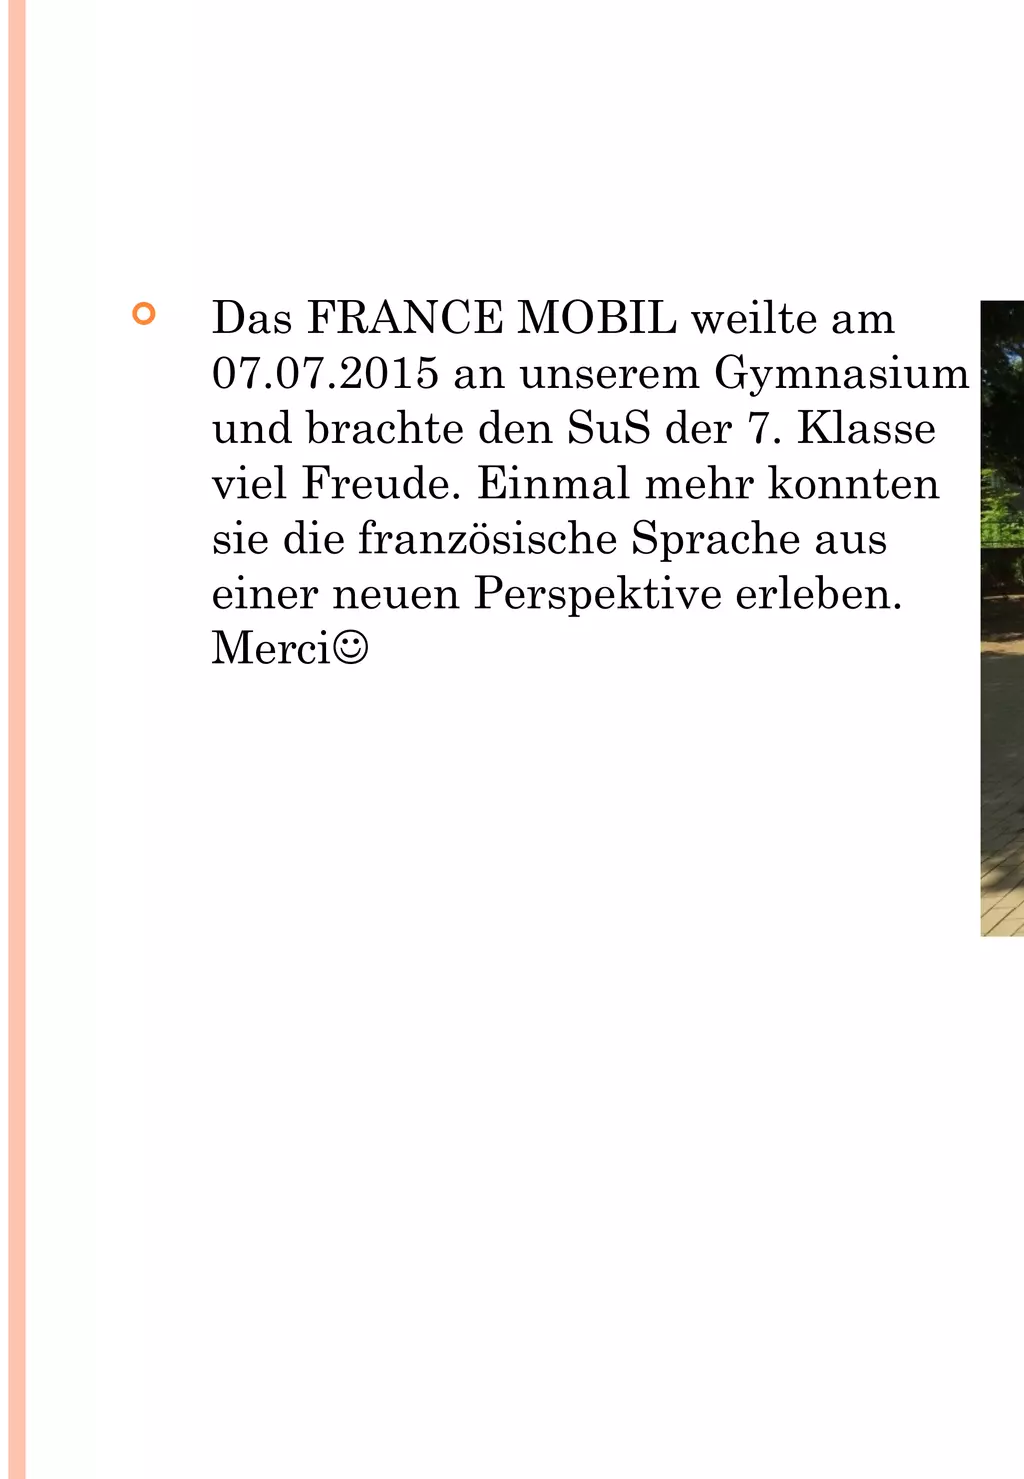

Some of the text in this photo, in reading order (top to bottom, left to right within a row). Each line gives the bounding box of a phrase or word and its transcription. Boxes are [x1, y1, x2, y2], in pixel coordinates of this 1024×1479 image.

[213, 299, 895, 334] Das FRANCE MOBIL weilte am
[213, 354, 969, 397] 07.07.2015 an unserem Gymnasium
[212, 409, 935, 444] und brachte den SuS der 7. Klasse
[212, 465, 940, 499] viel Freude. Einmal mehr konnten
[214, 520, 886, 562] sie die französische Sprache aus
[213, 575, 900, 617] einer neuen Perspektive erleben.
[212, 630, 330, 664] Merci
